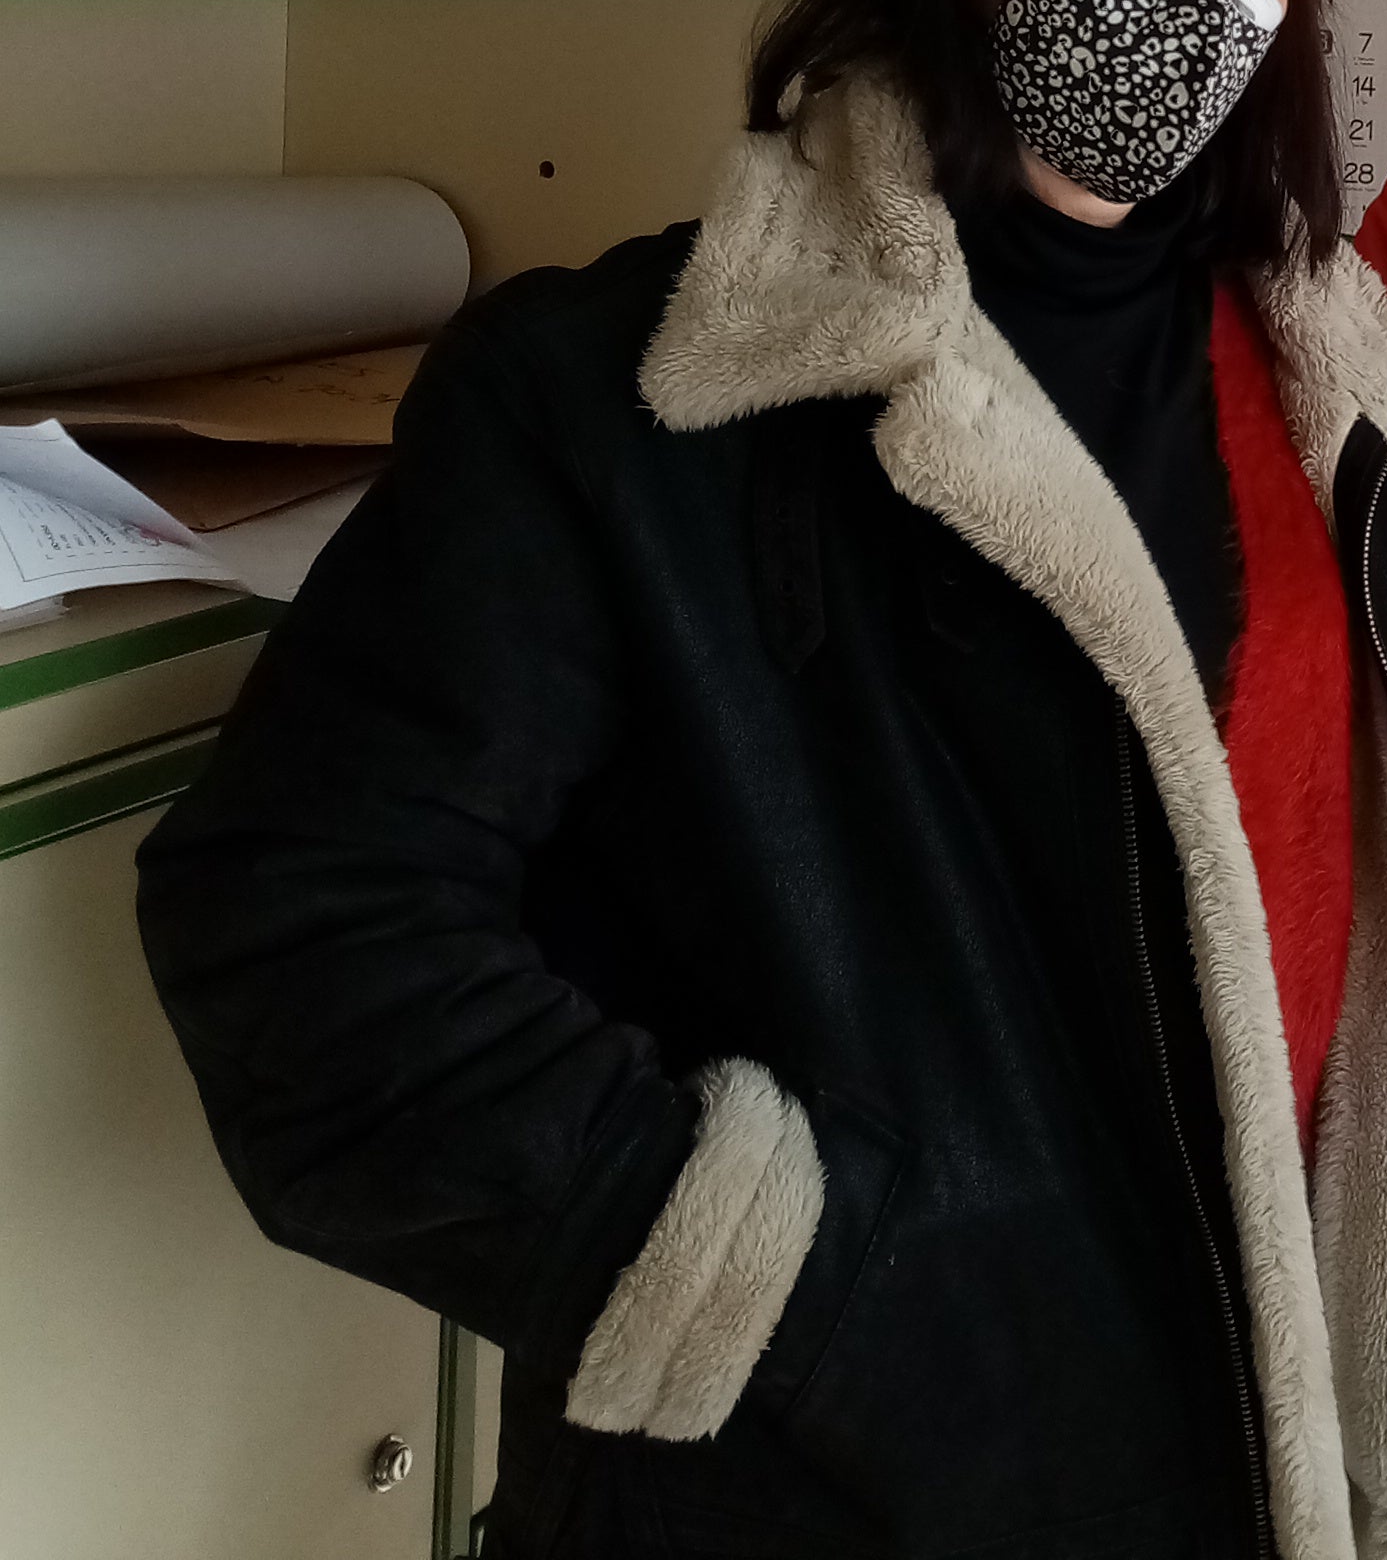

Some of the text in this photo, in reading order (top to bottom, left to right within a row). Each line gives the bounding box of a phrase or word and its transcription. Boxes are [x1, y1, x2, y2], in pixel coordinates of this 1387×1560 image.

[1358, 33, 1373, 54] 7
[1352, 76, 1376, 97] 14
[1349, 119, 1374, 141] 21
[1343, 162, 1374, 184] 28
